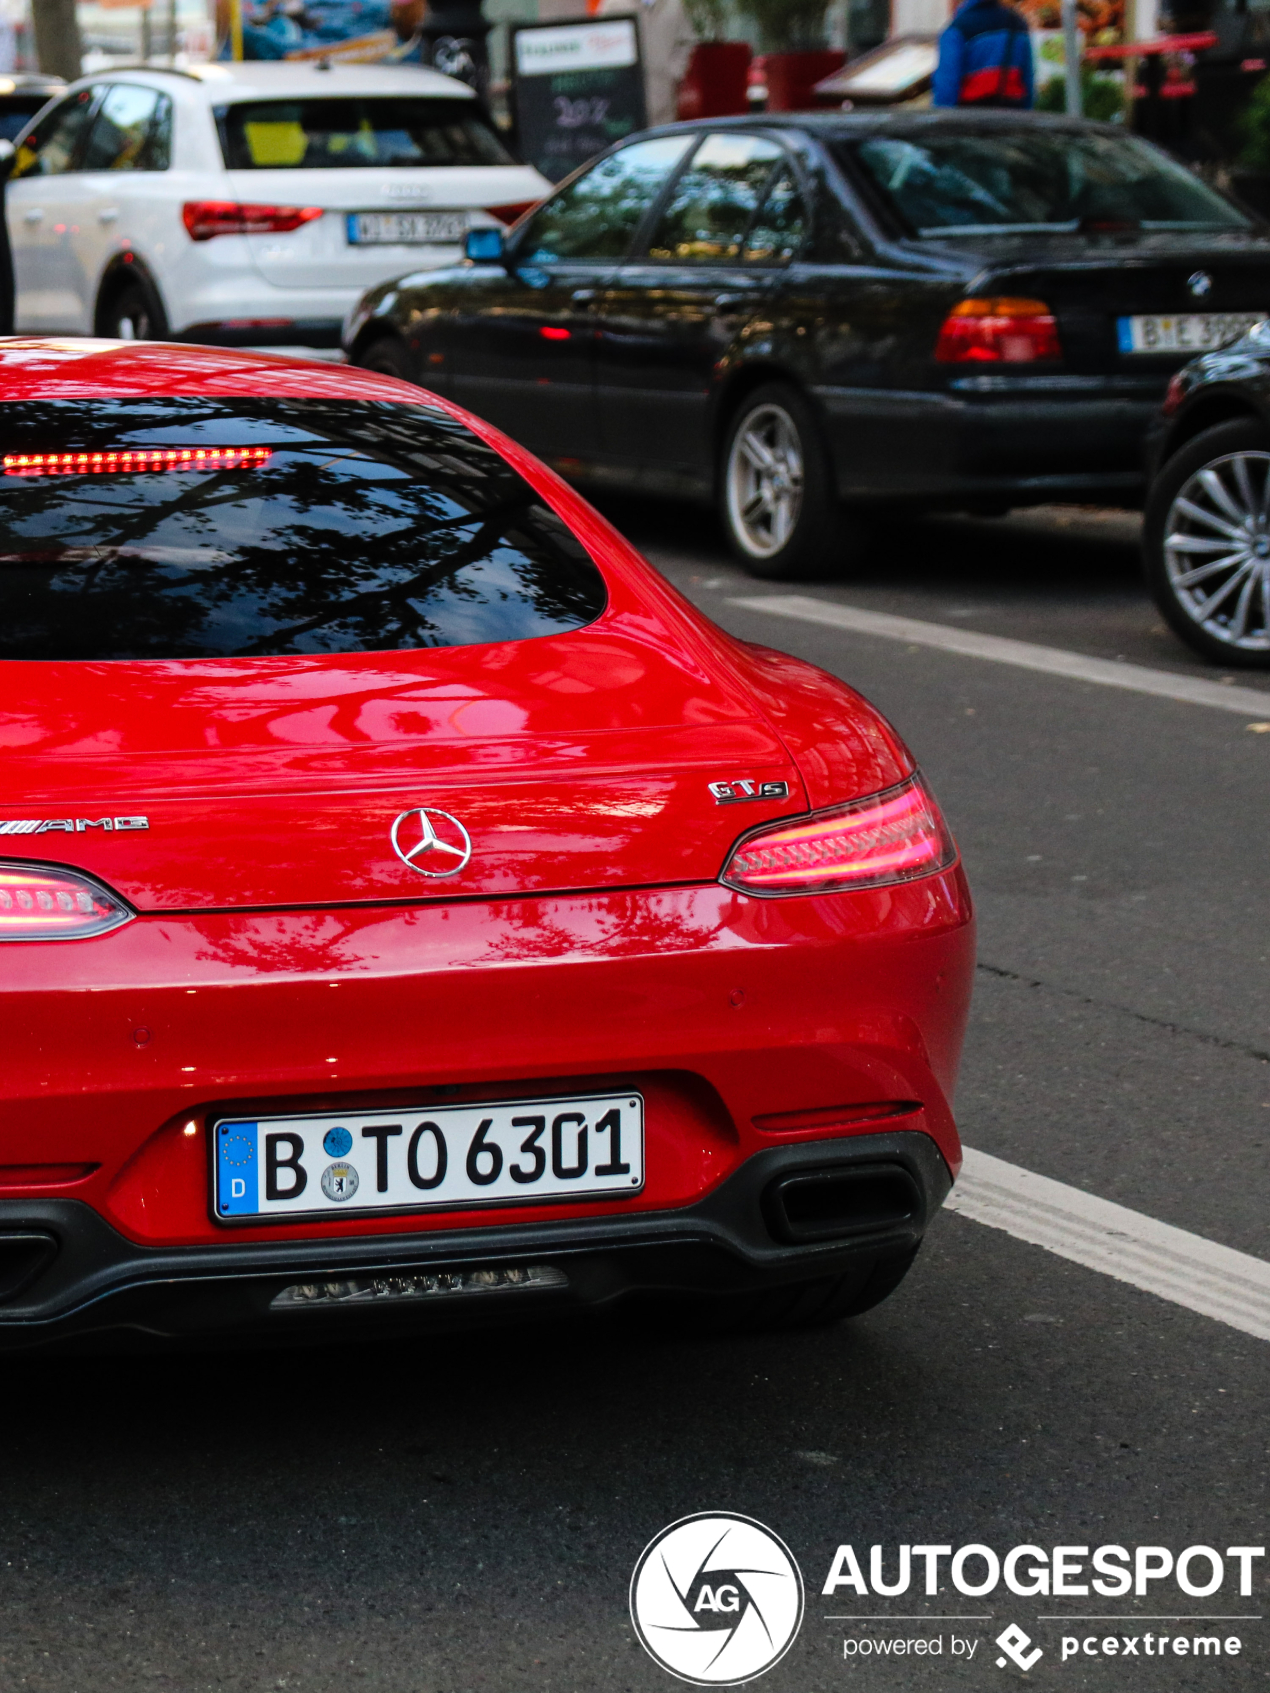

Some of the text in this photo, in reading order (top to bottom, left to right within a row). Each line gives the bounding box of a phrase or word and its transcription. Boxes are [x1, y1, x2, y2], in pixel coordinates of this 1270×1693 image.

[1143, 318, 1158, 346] B
[35, 816, 150, 834] AMG
[231, 1108, 632, 1201] D B TO 6301
